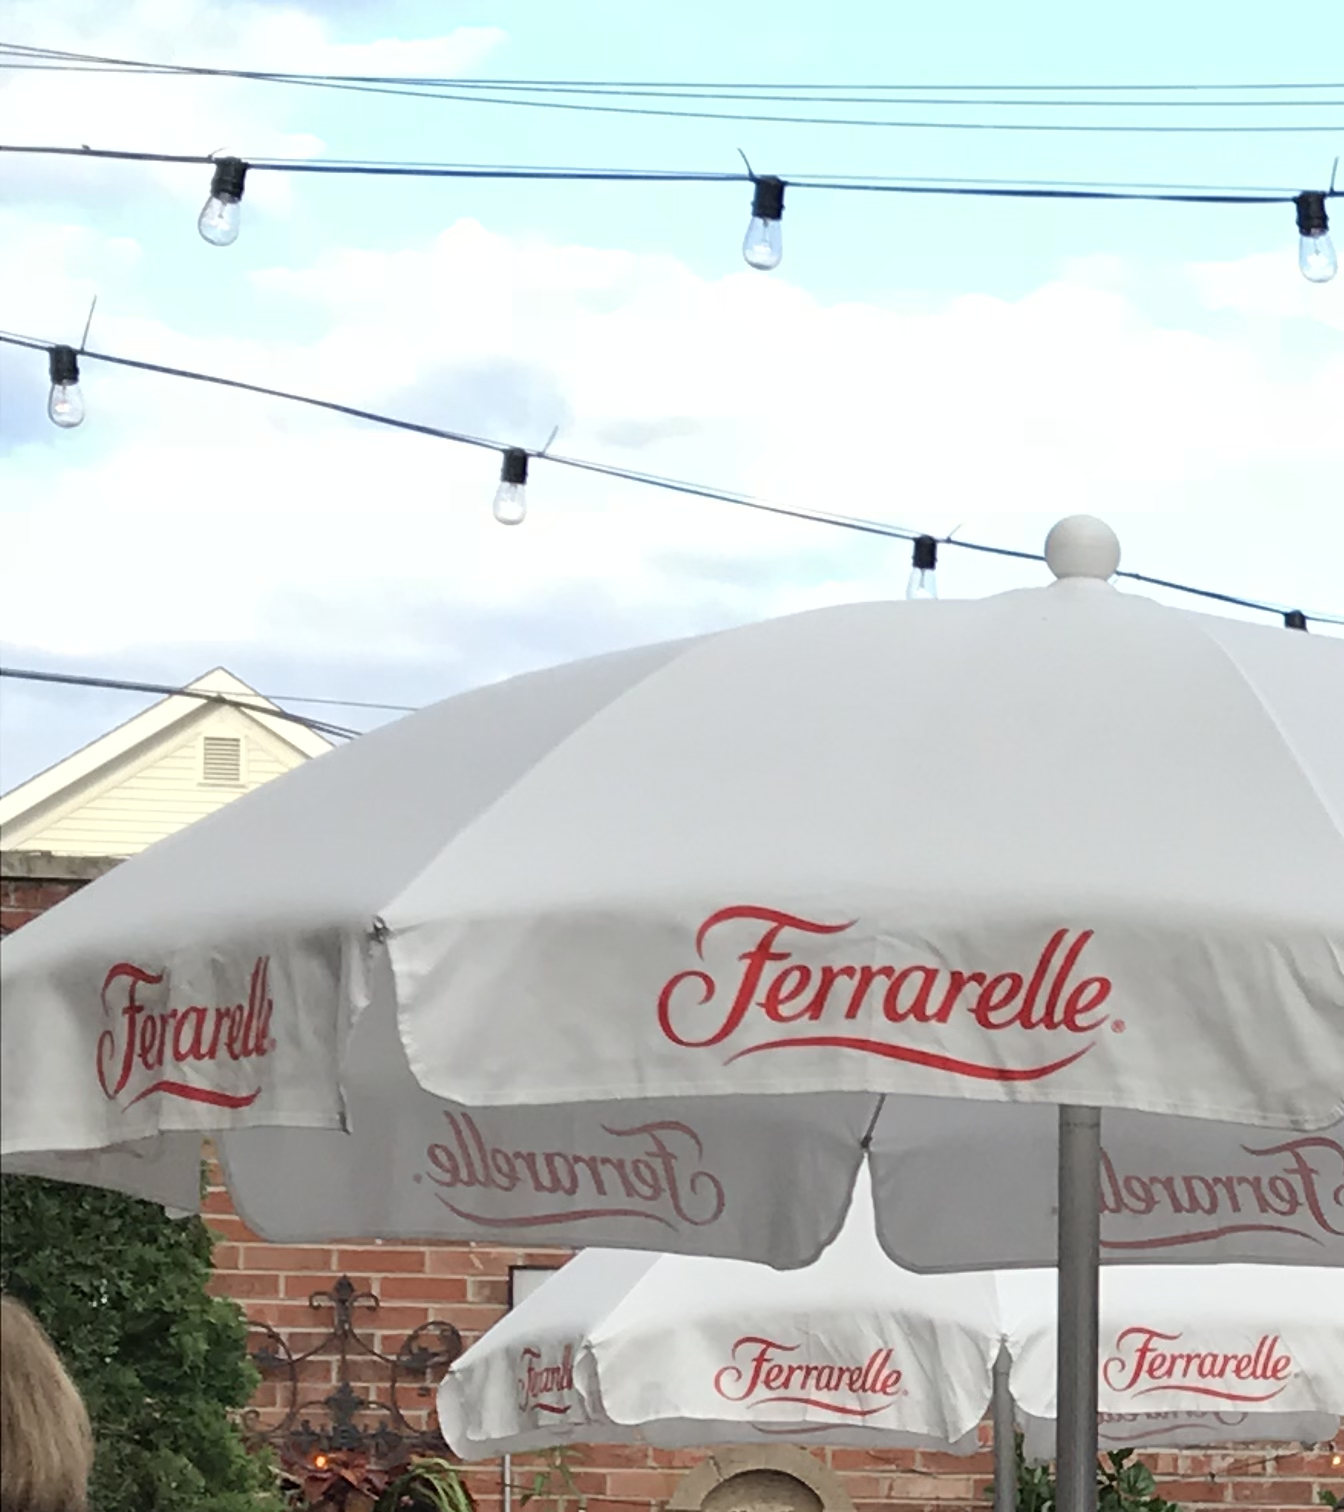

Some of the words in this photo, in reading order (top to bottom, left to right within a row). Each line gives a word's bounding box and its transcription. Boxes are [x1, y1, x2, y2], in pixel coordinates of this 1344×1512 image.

[656, 904, 1112, 1047] Ferrarelle
[713, 1336, 902, 1400] Ferrarelle
[1103, 1326, 1293, 1392] Ferrarelle
